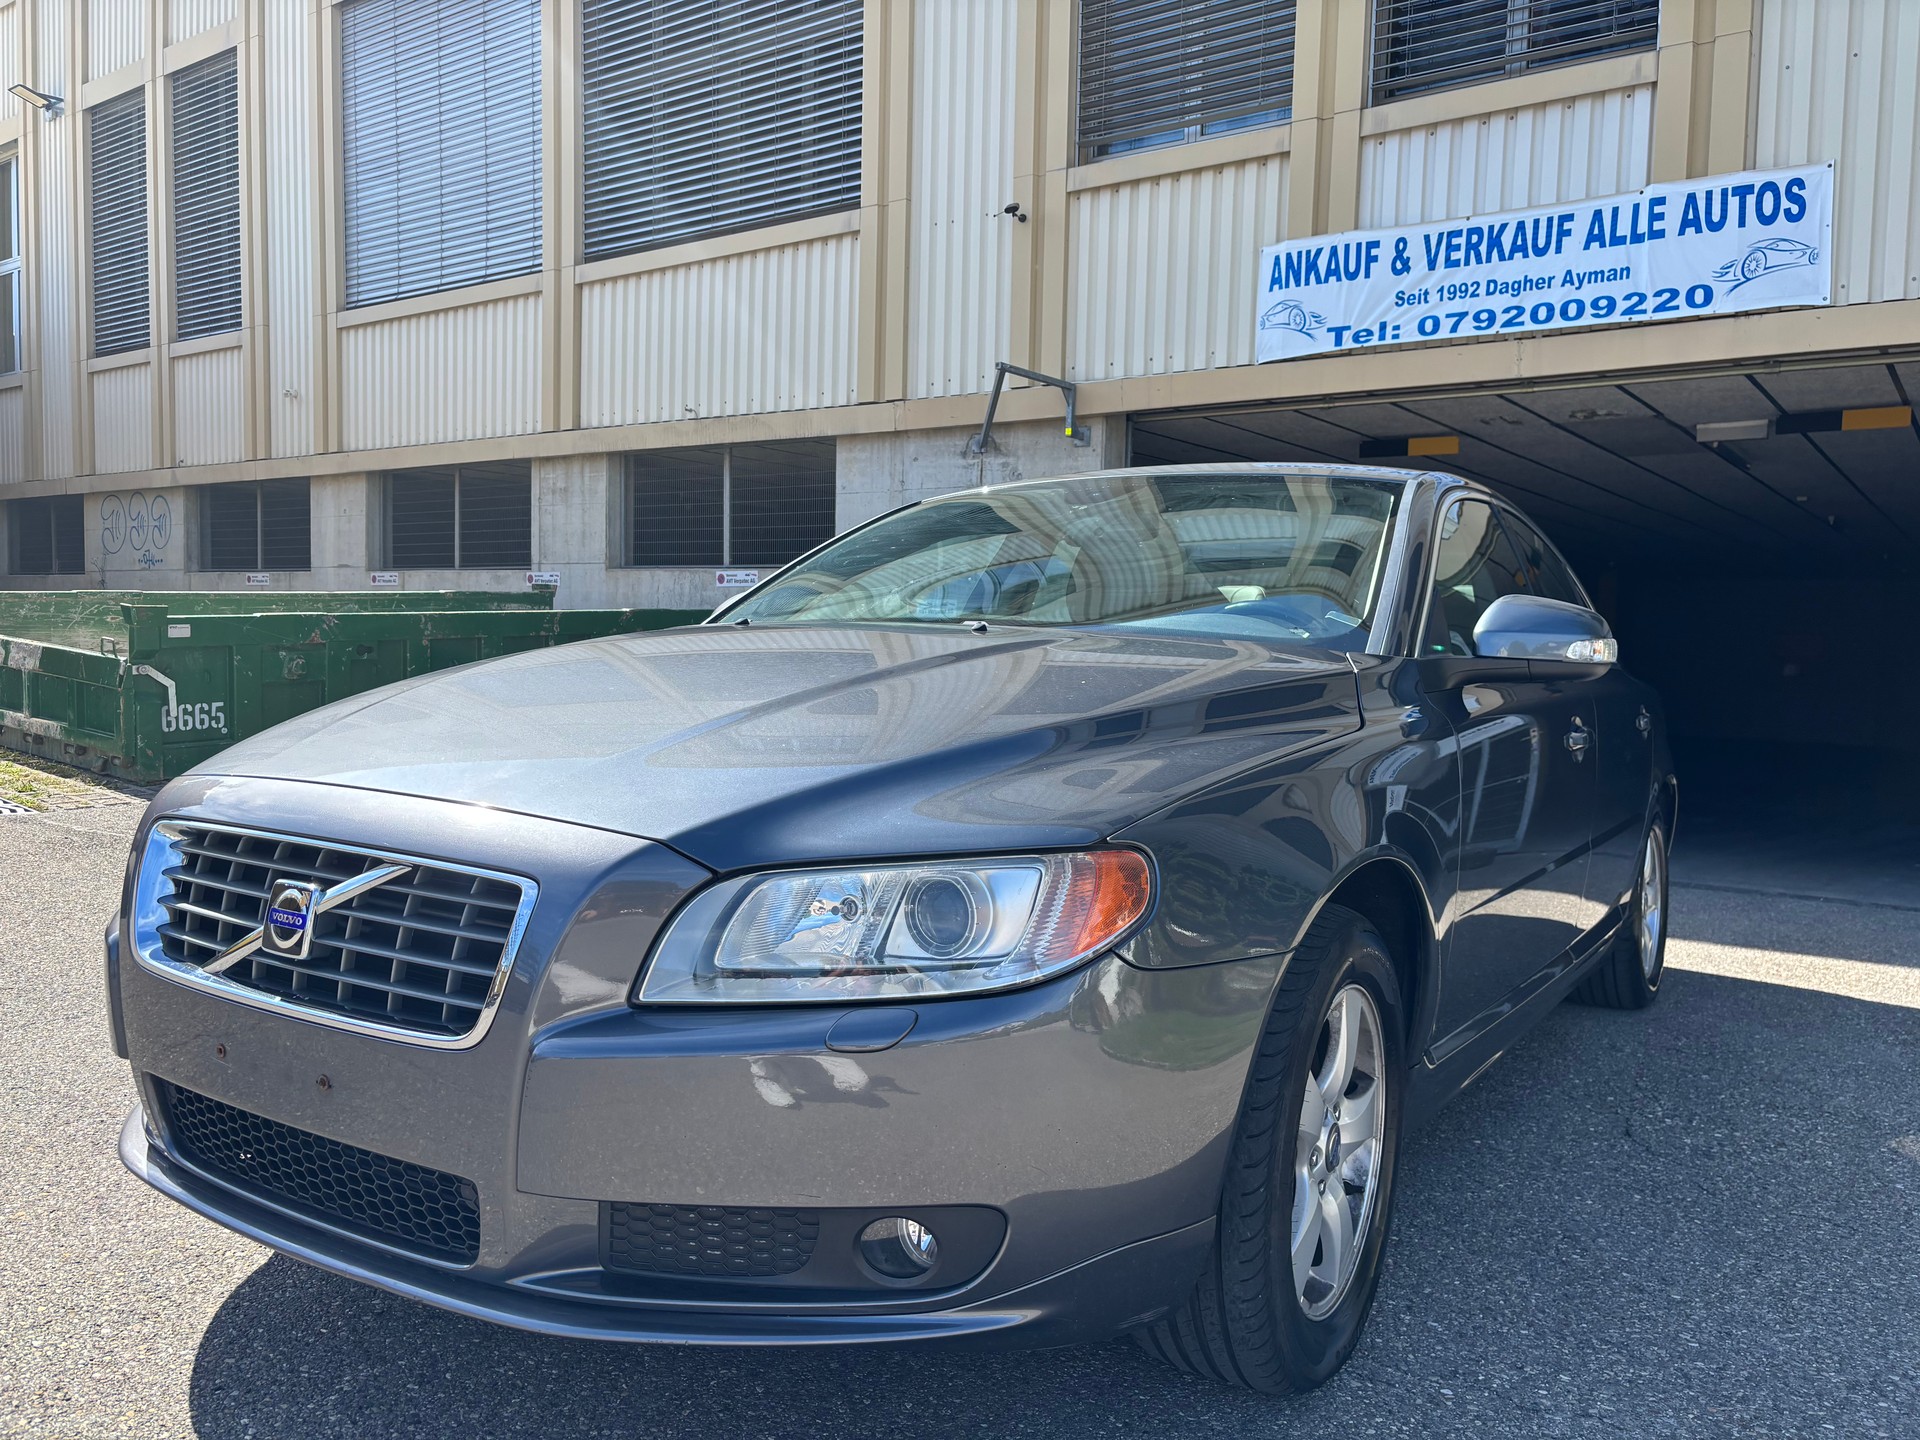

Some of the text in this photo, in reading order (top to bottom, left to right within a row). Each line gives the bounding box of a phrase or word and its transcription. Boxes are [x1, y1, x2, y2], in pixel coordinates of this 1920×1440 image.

[1268, 177, 1807, 293] ANKAUF & VERKAUF ALLE AUTOS
[1394, 265, 1631, 307] Seit 1992 Dagher Ayman
[1326, 284, 1714, 347] Tel: 0792009220
[161, 702, 225, 732] 6665
[271, 911, 303, 926] VOLVO
